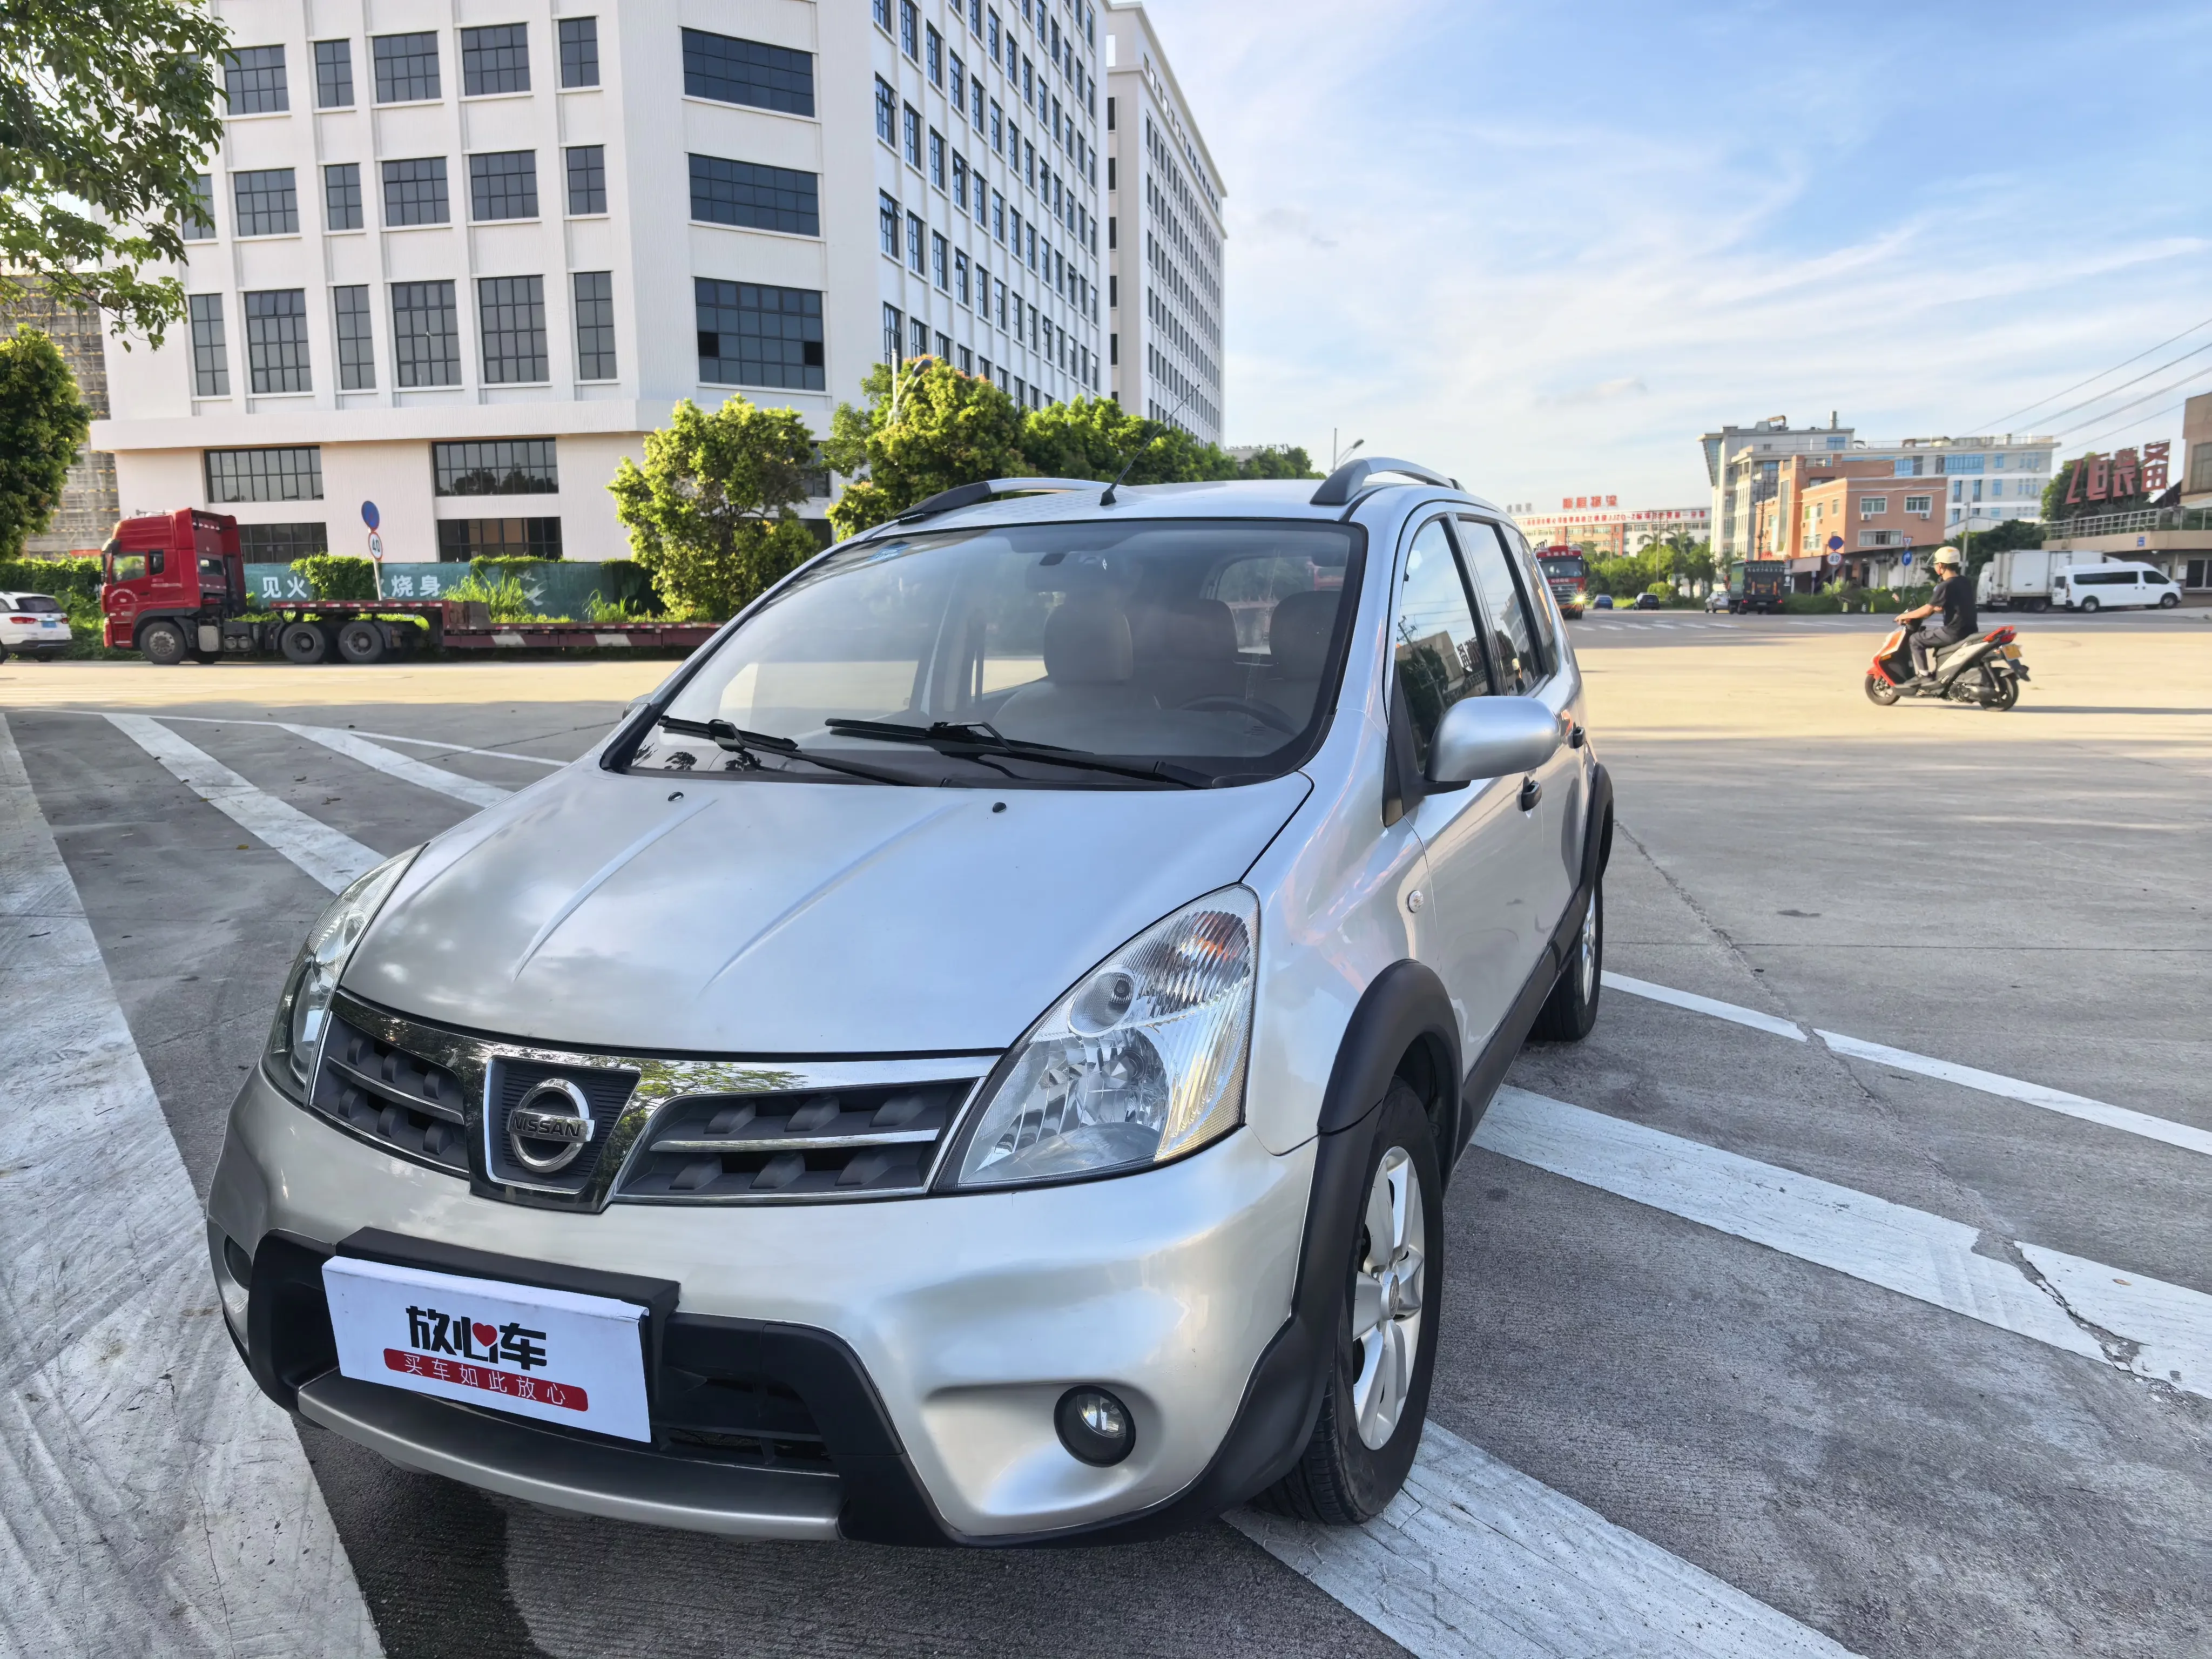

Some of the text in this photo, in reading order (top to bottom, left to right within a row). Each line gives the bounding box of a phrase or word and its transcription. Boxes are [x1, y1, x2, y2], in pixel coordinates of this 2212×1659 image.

[380, 575, 441, 597] 烧身
[511, 1115, 581, 1137] NISSAN
[406, 1305, 548, 1371] 放心车
[403, 1353, 566, 1405] 买车如此放心
